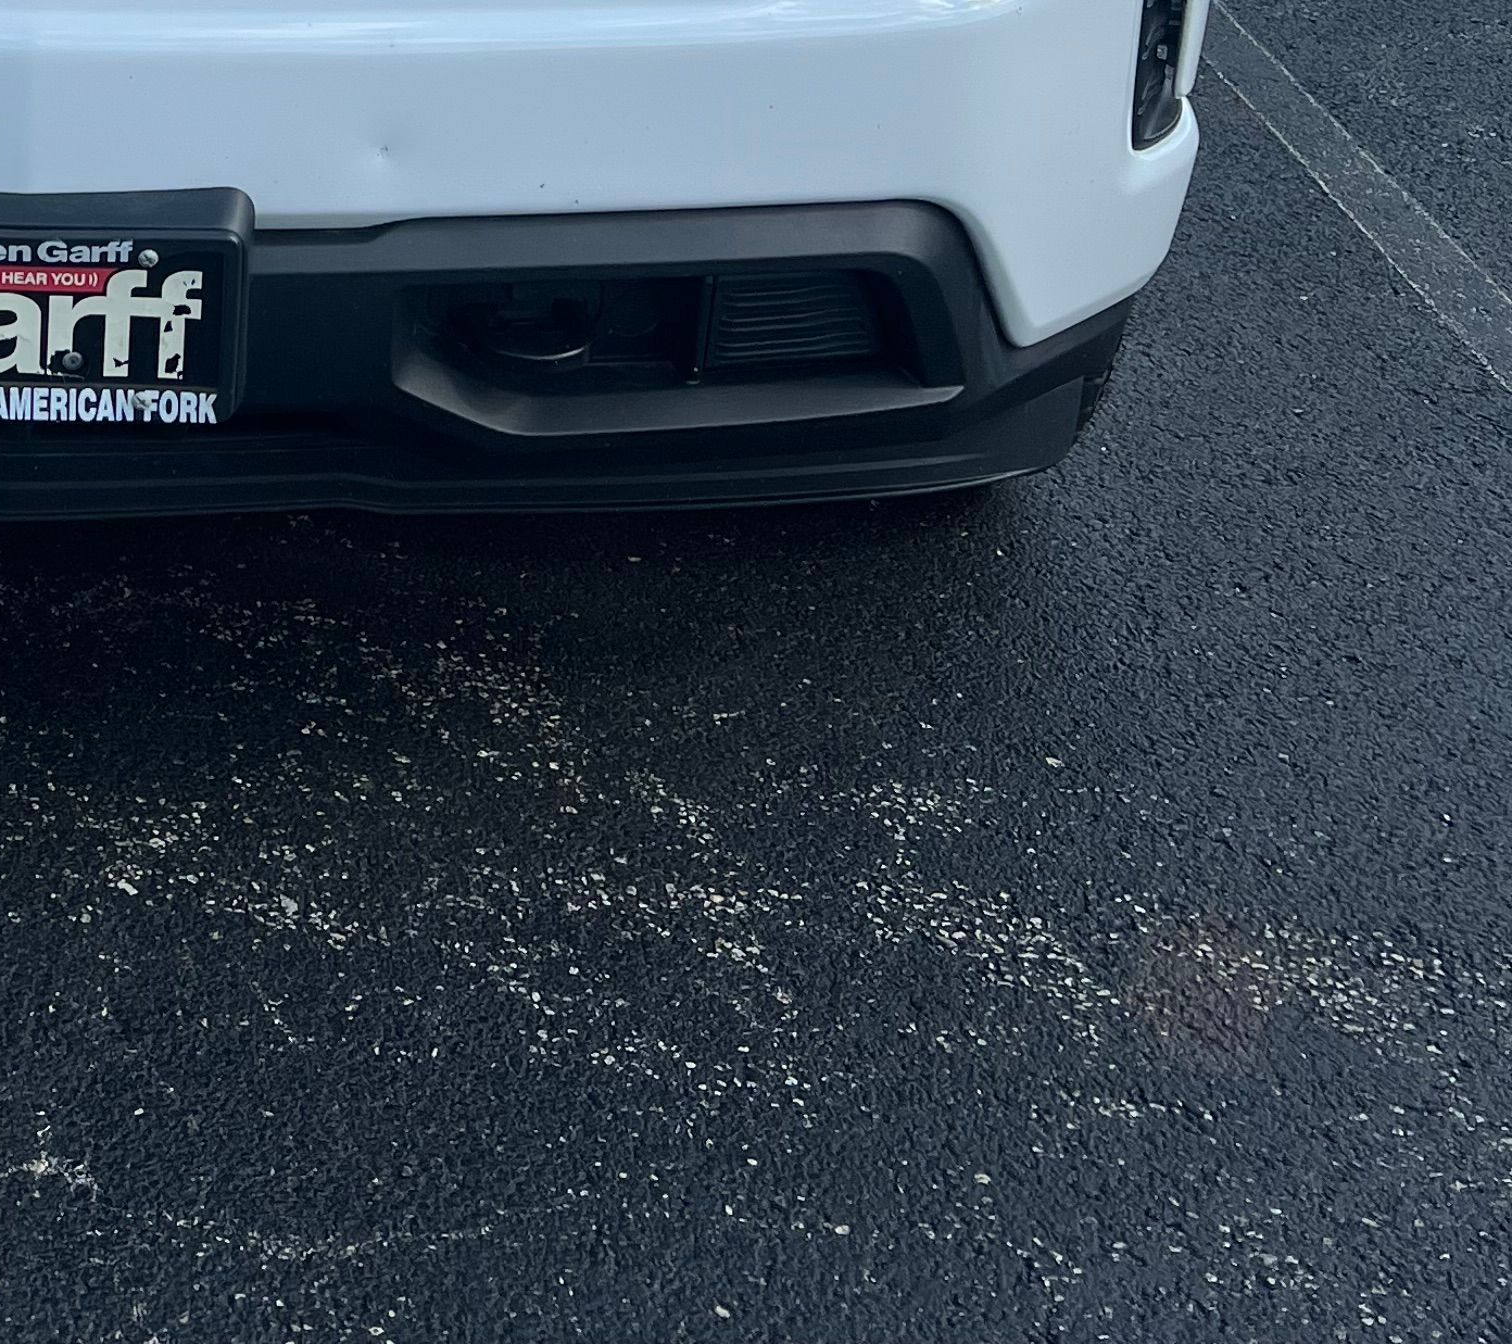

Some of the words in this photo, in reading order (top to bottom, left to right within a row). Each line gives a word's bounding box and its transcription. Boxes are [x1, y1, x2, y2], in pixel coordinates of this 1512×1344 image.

[37, 238, 133, 264] Garff
[1, 271, 48, 286] HEAR
[51, 272, 86, 287] YOU
[142, 389, 218, 424] FORK
